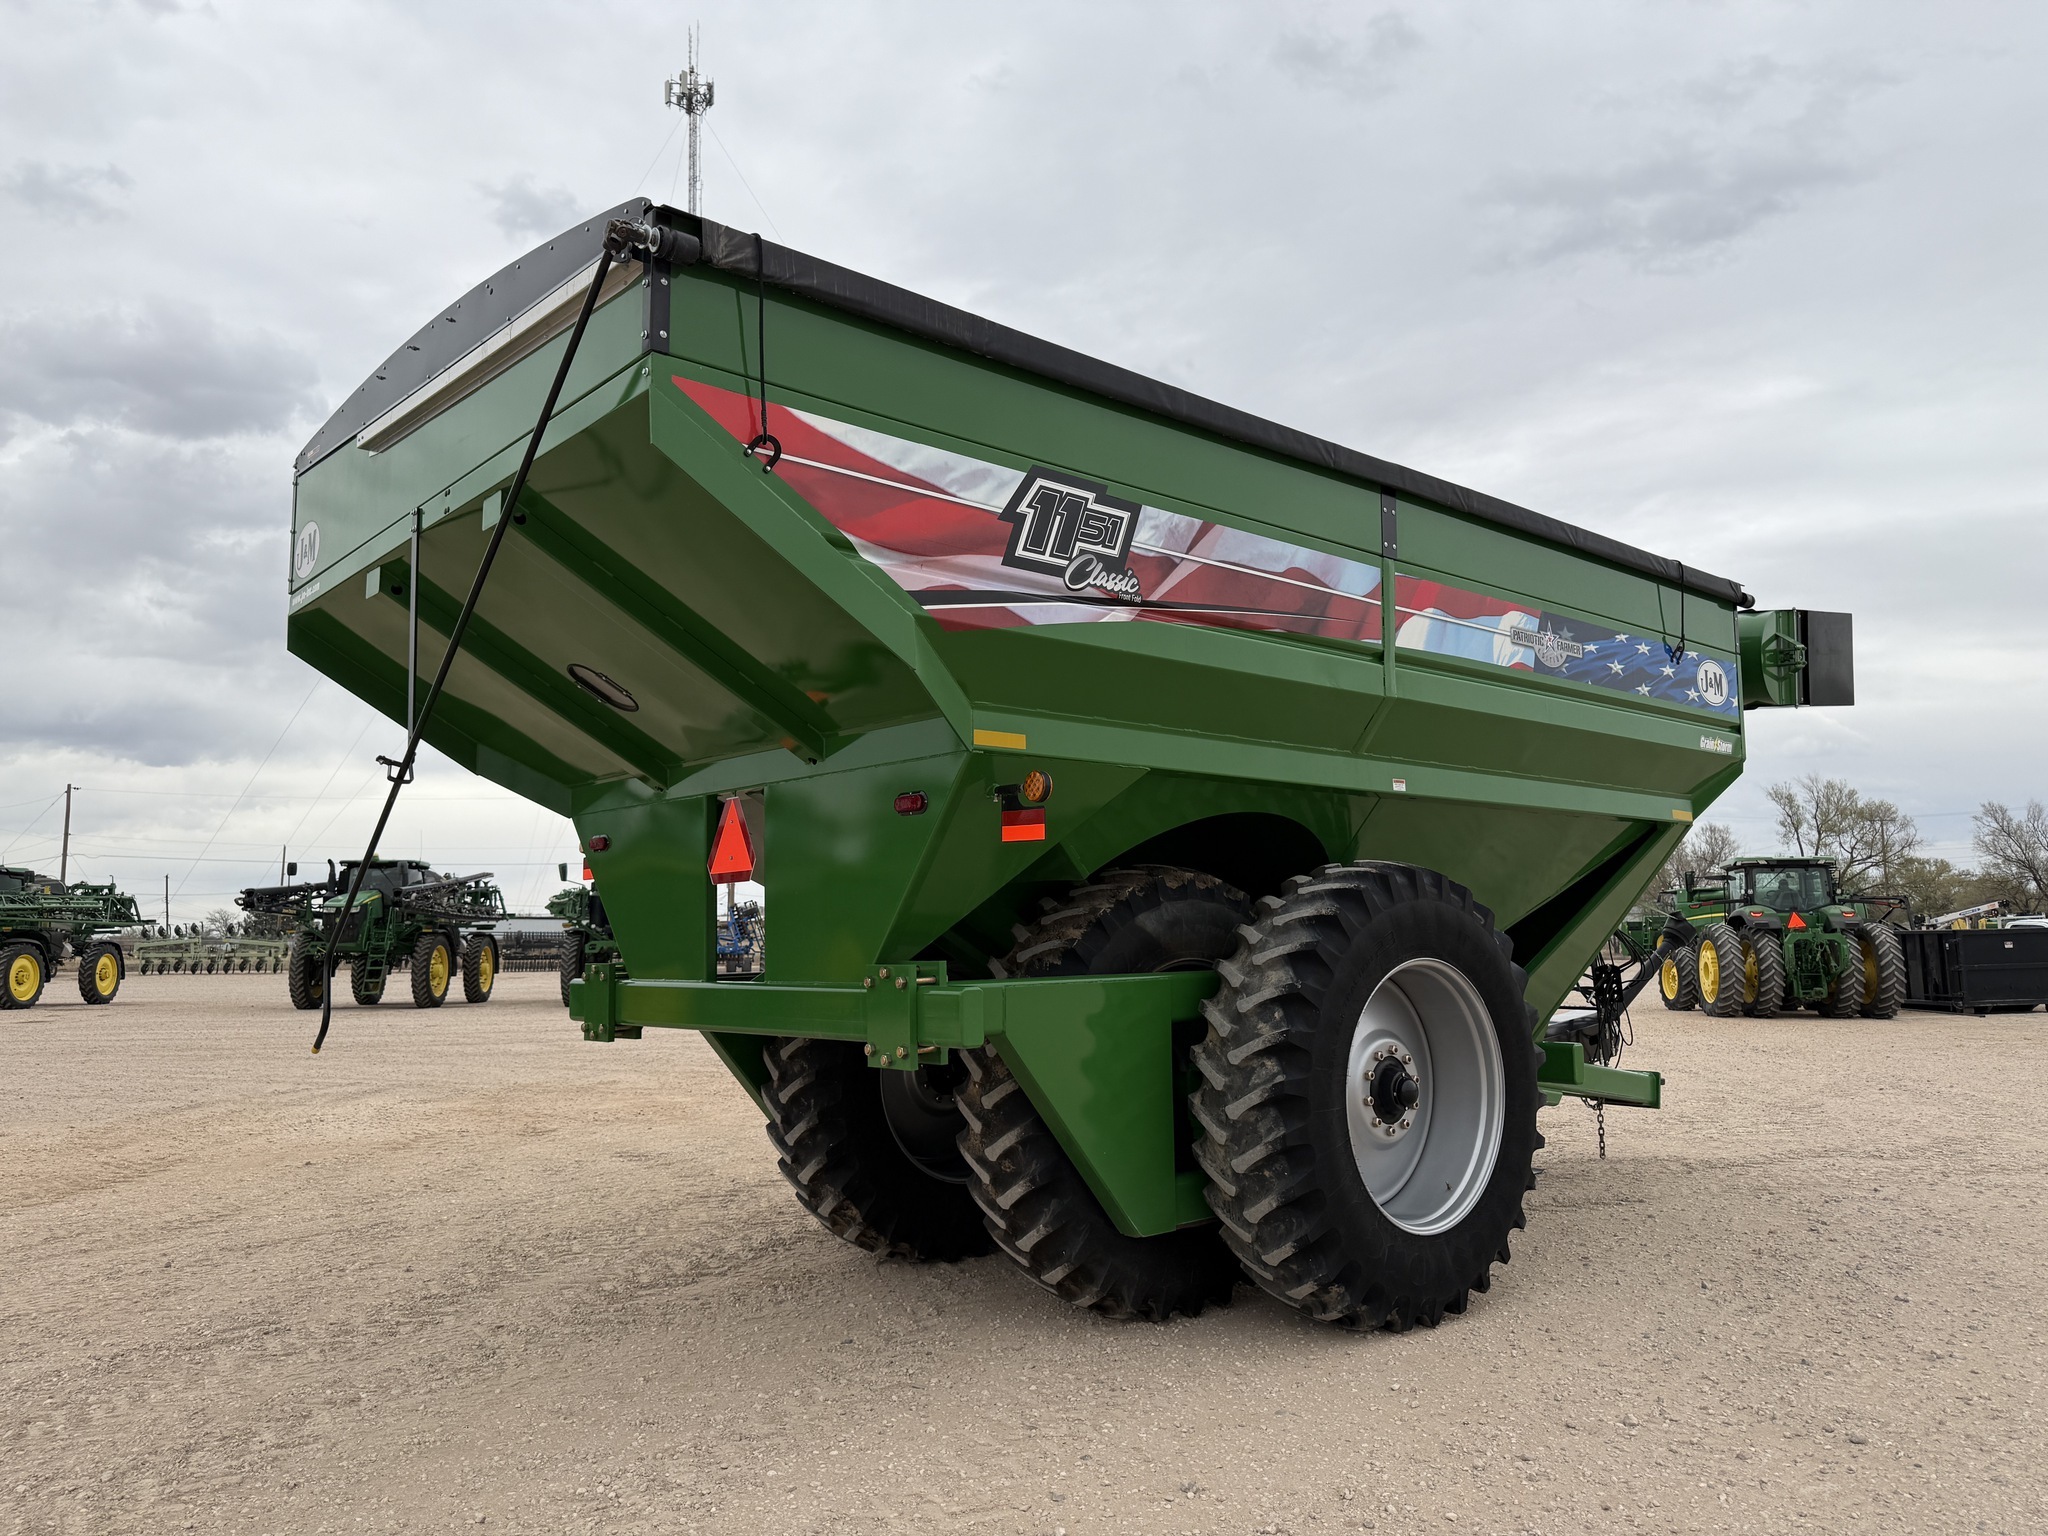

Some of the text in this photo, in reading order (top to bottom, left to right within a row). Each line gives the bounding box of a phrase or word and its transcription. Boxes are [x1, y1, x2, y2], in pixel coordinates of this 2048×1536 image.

[1021, 484, 1125, 559] 1151
[297, 528, 317, 571] J&M
[1065, 554, 1139, 593] Classic
[1512, 629, 1581, 656] PATRIOTIC FARMER
[1700, 669, 1724, 697] J&M
